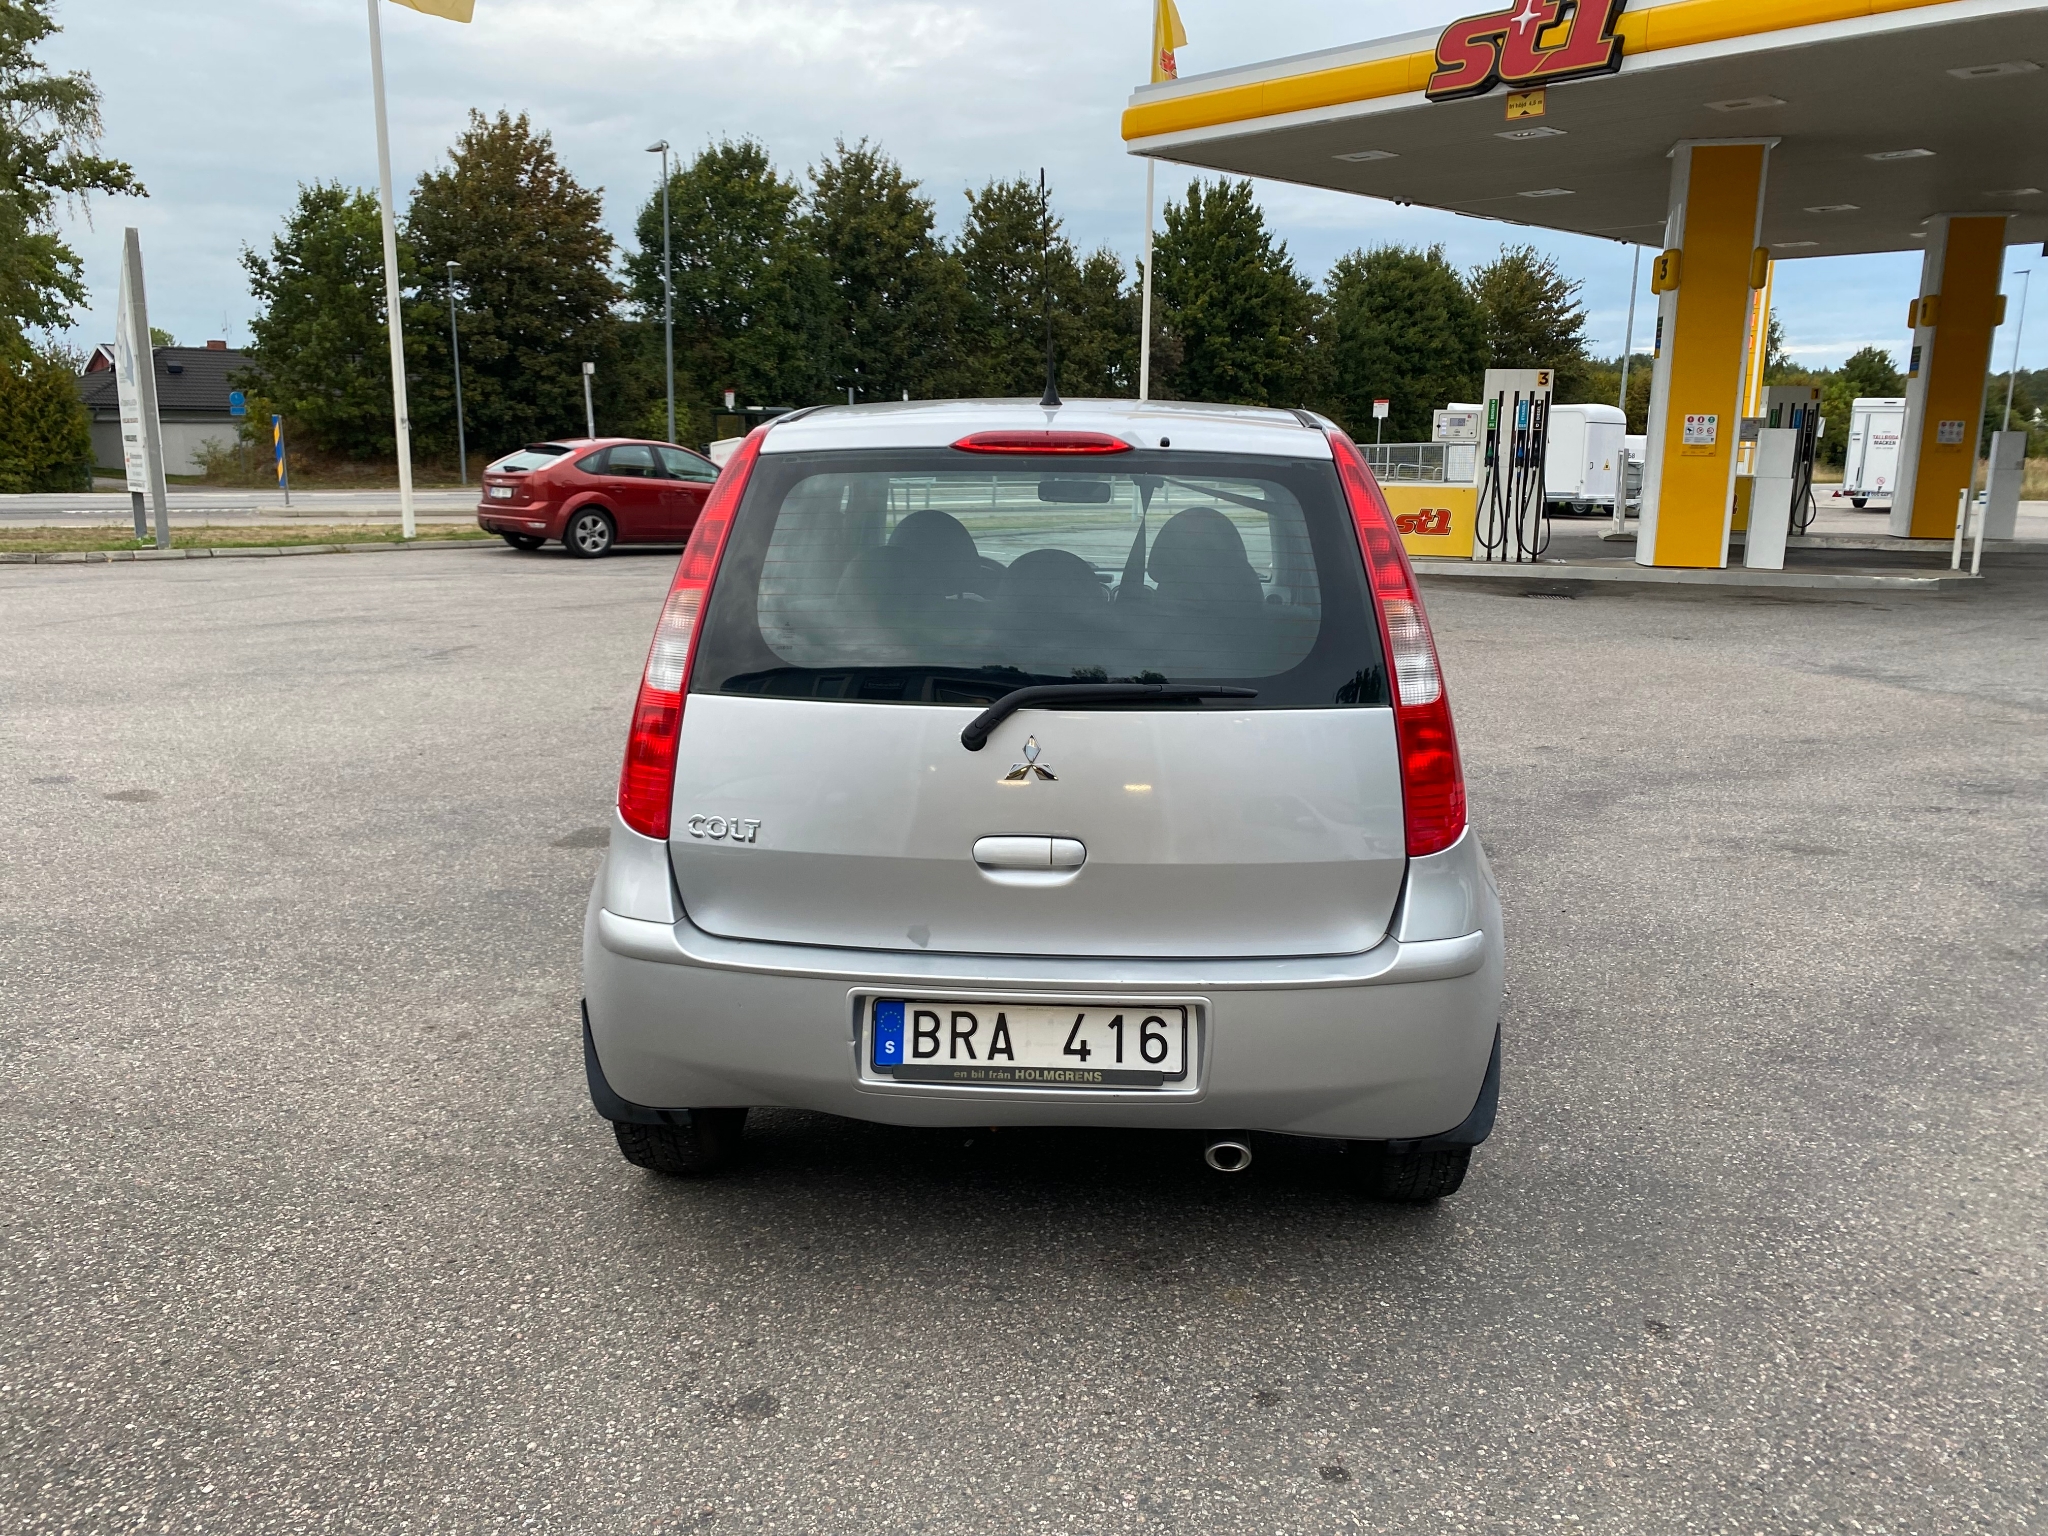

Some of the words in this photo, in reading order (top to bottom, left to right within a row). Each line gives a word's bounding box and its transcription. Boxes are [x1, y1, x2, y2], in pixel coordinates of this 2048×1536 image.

[1660, 258, 1669, 281] 3
[1539, 372, 1549, 385] 3
[1395, 508, 1452, 536] st1
[688, 813, 761, 844] COLT
[885, 1041, 895, 1054] S
[912, 1010, 1014, 1061] BRA
[1063, 1013, 1168, 1064] 416
[971, 1069, 985, 1079] bil
[989, 1069, 1011, 1080] från
[1015, 1069, 1102, 1082] HOLMGRENS
